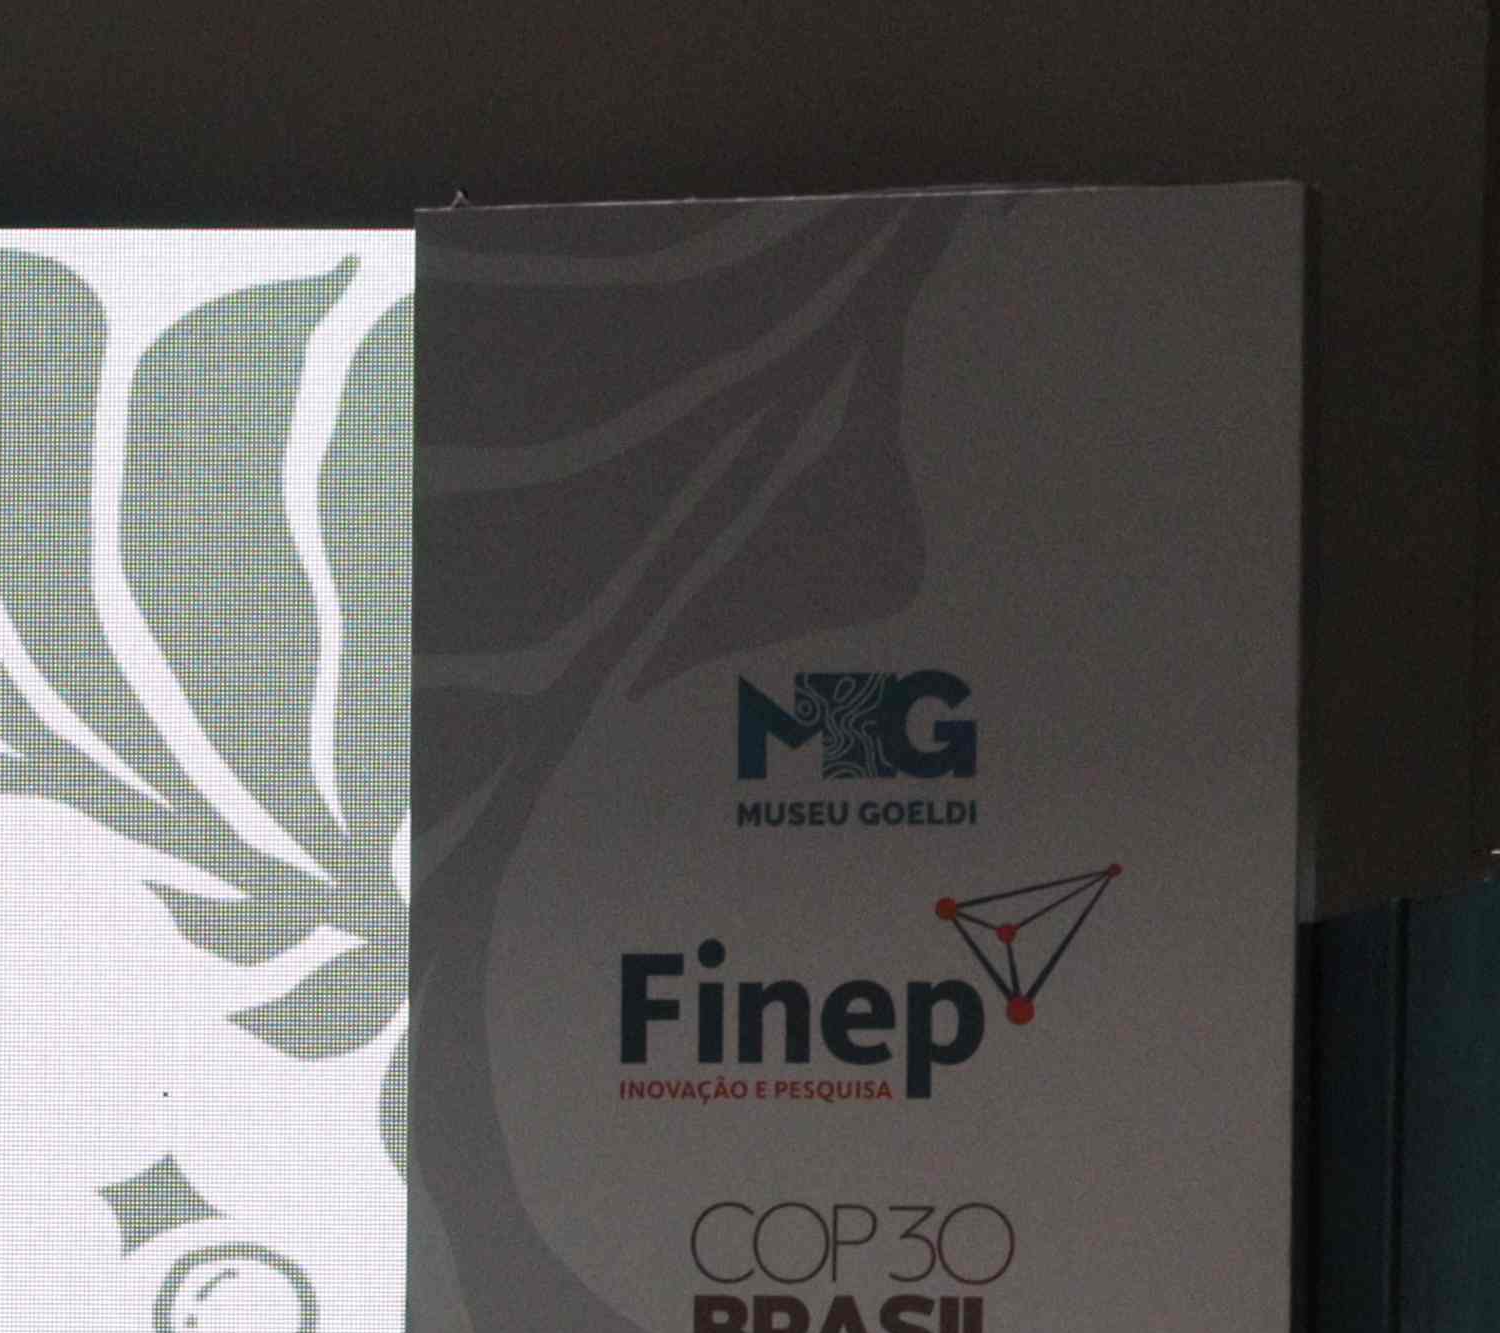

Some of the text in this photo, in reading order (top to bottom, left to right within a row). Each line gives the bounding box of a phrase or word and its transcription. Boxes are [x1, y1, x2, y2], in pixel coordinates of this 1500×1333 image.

[737, 800, 977, 827] MUSEU GOELDI
[620, 938, 986, 1099] Finep
[619, 1077, 893, 1105] INOVAÇÃO E PESQUISA
